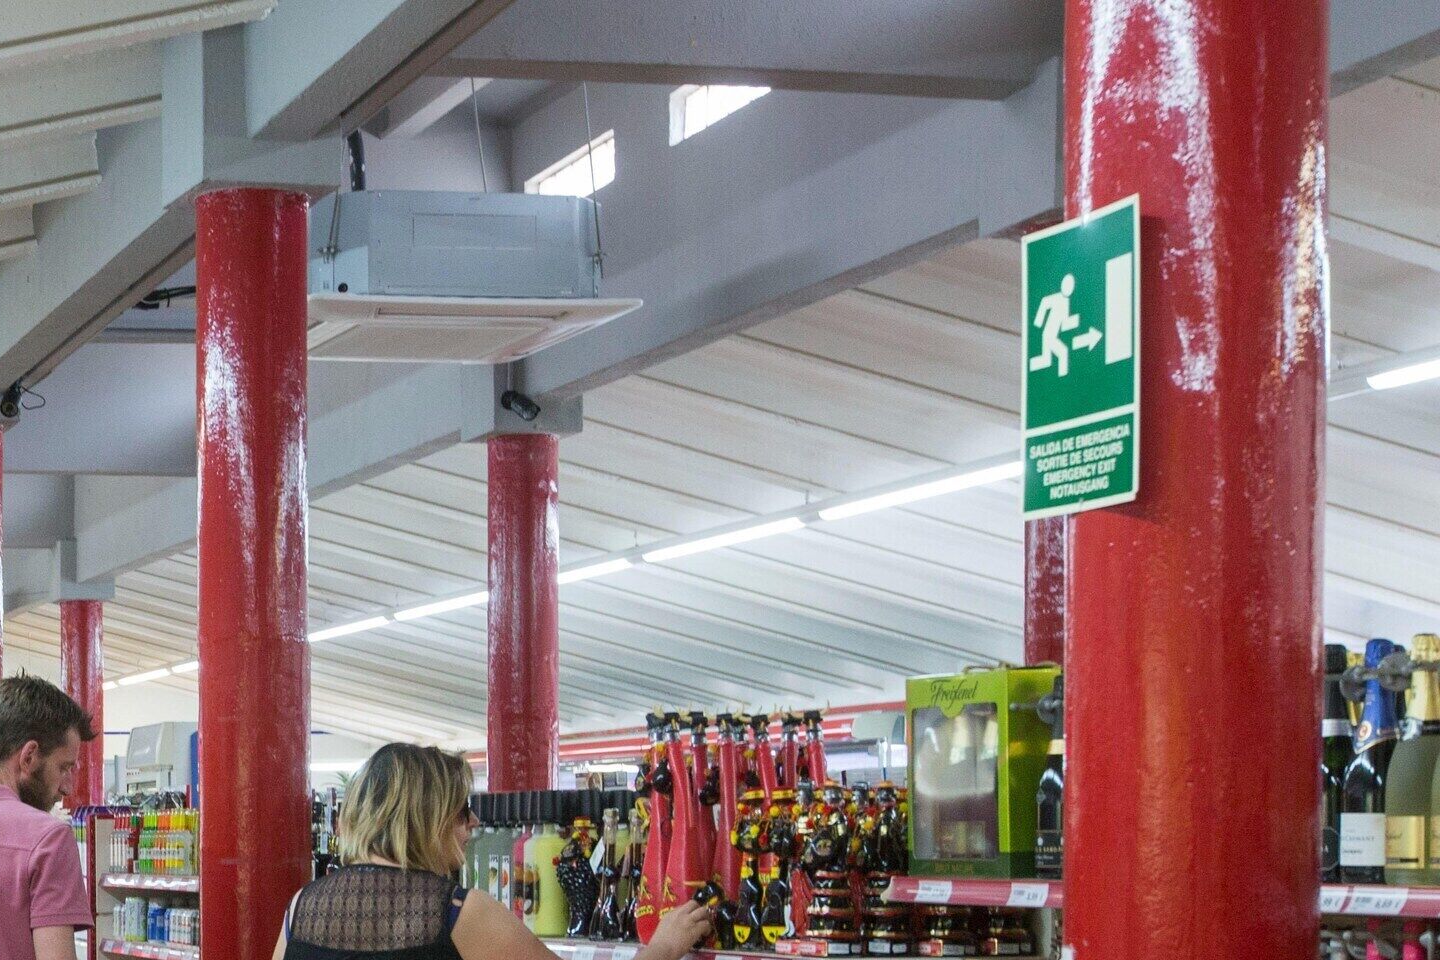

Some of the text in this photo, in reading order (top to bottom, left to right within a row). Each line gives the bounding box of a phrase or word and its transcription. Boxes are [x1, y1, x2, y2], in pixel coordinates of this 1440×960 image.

[1029, 423, 1130, 459] SALIDA DE EMERGENCIA
[1036, 441, 1123, 473] SORTIE DE SECOURS
[1043, 457, 1116, 486] EMERGENCY EXIT
[1050, 475, 1109, 500] NOTAUSGANG
